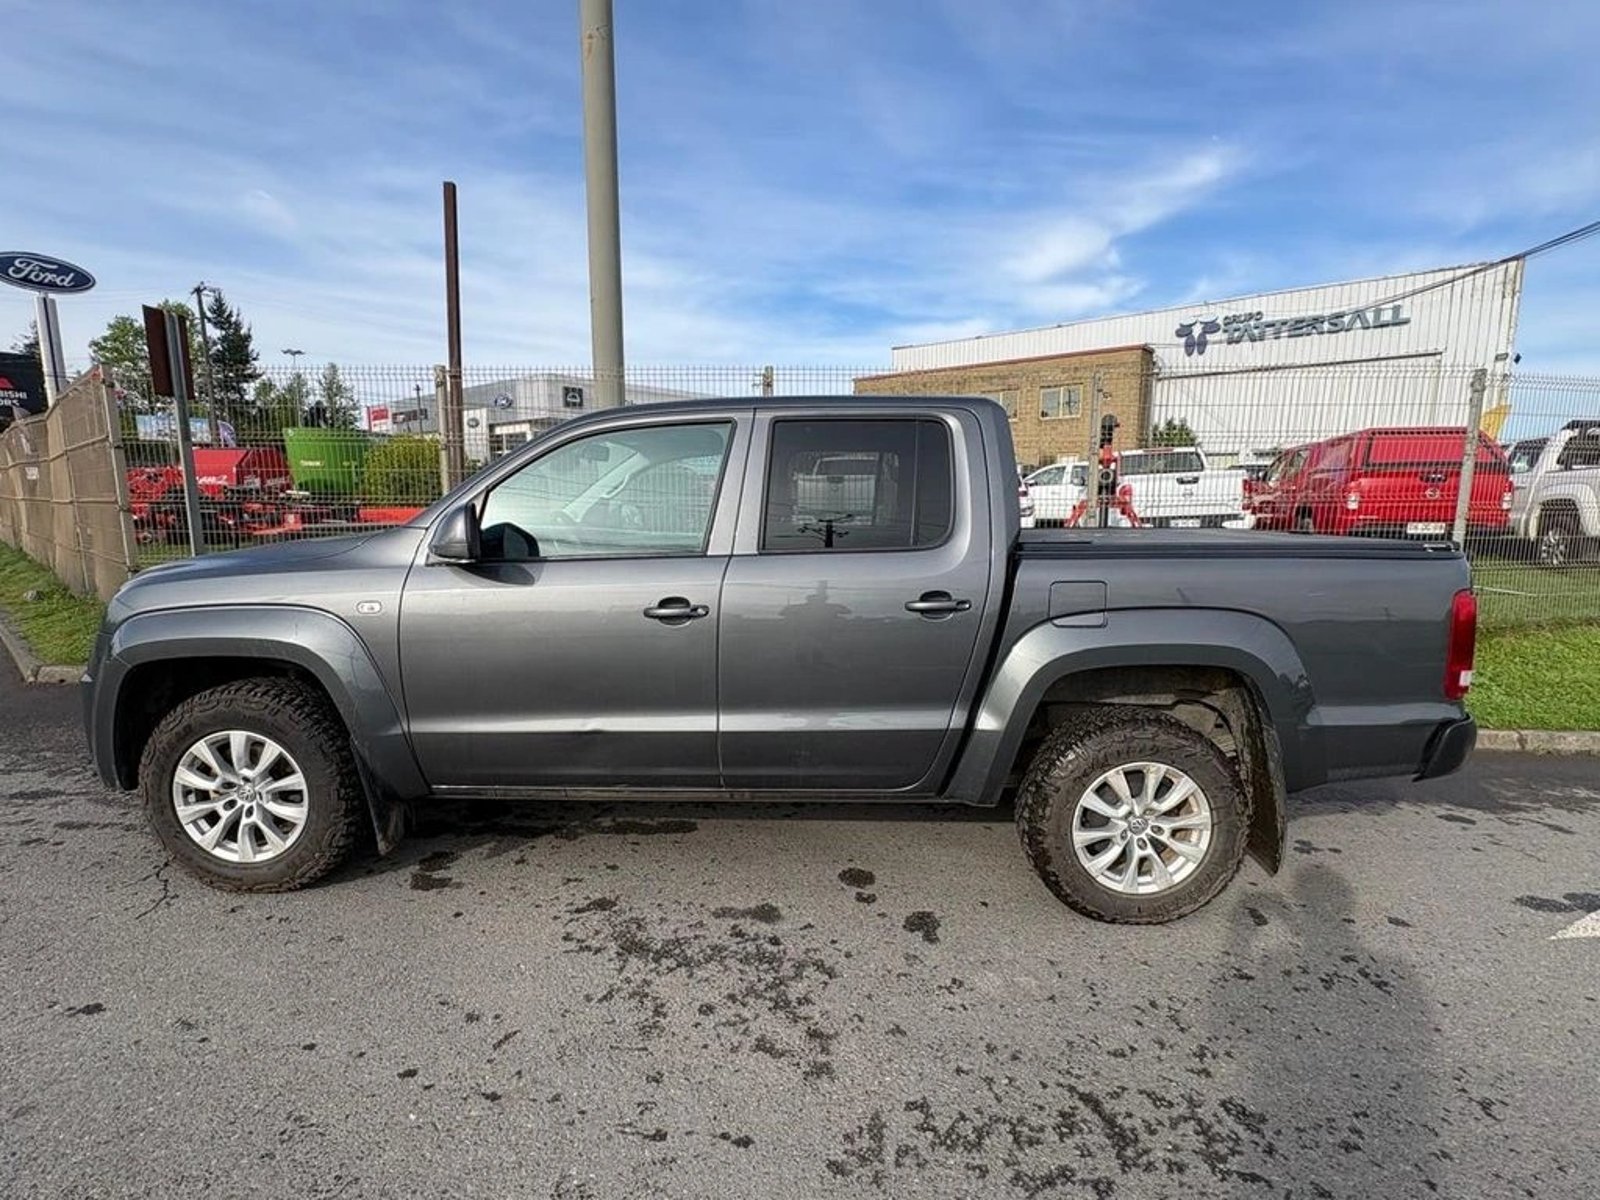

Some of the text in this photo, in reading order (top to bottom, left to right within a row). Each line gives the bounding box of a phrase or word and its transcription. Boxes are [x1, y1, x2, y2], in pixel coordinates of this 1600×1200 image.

[8, 258, 75, 286] Ford
[1222, 304, 1411, 344] TATTERSALL
[1223, 311, 1263, 327] GRUPO
